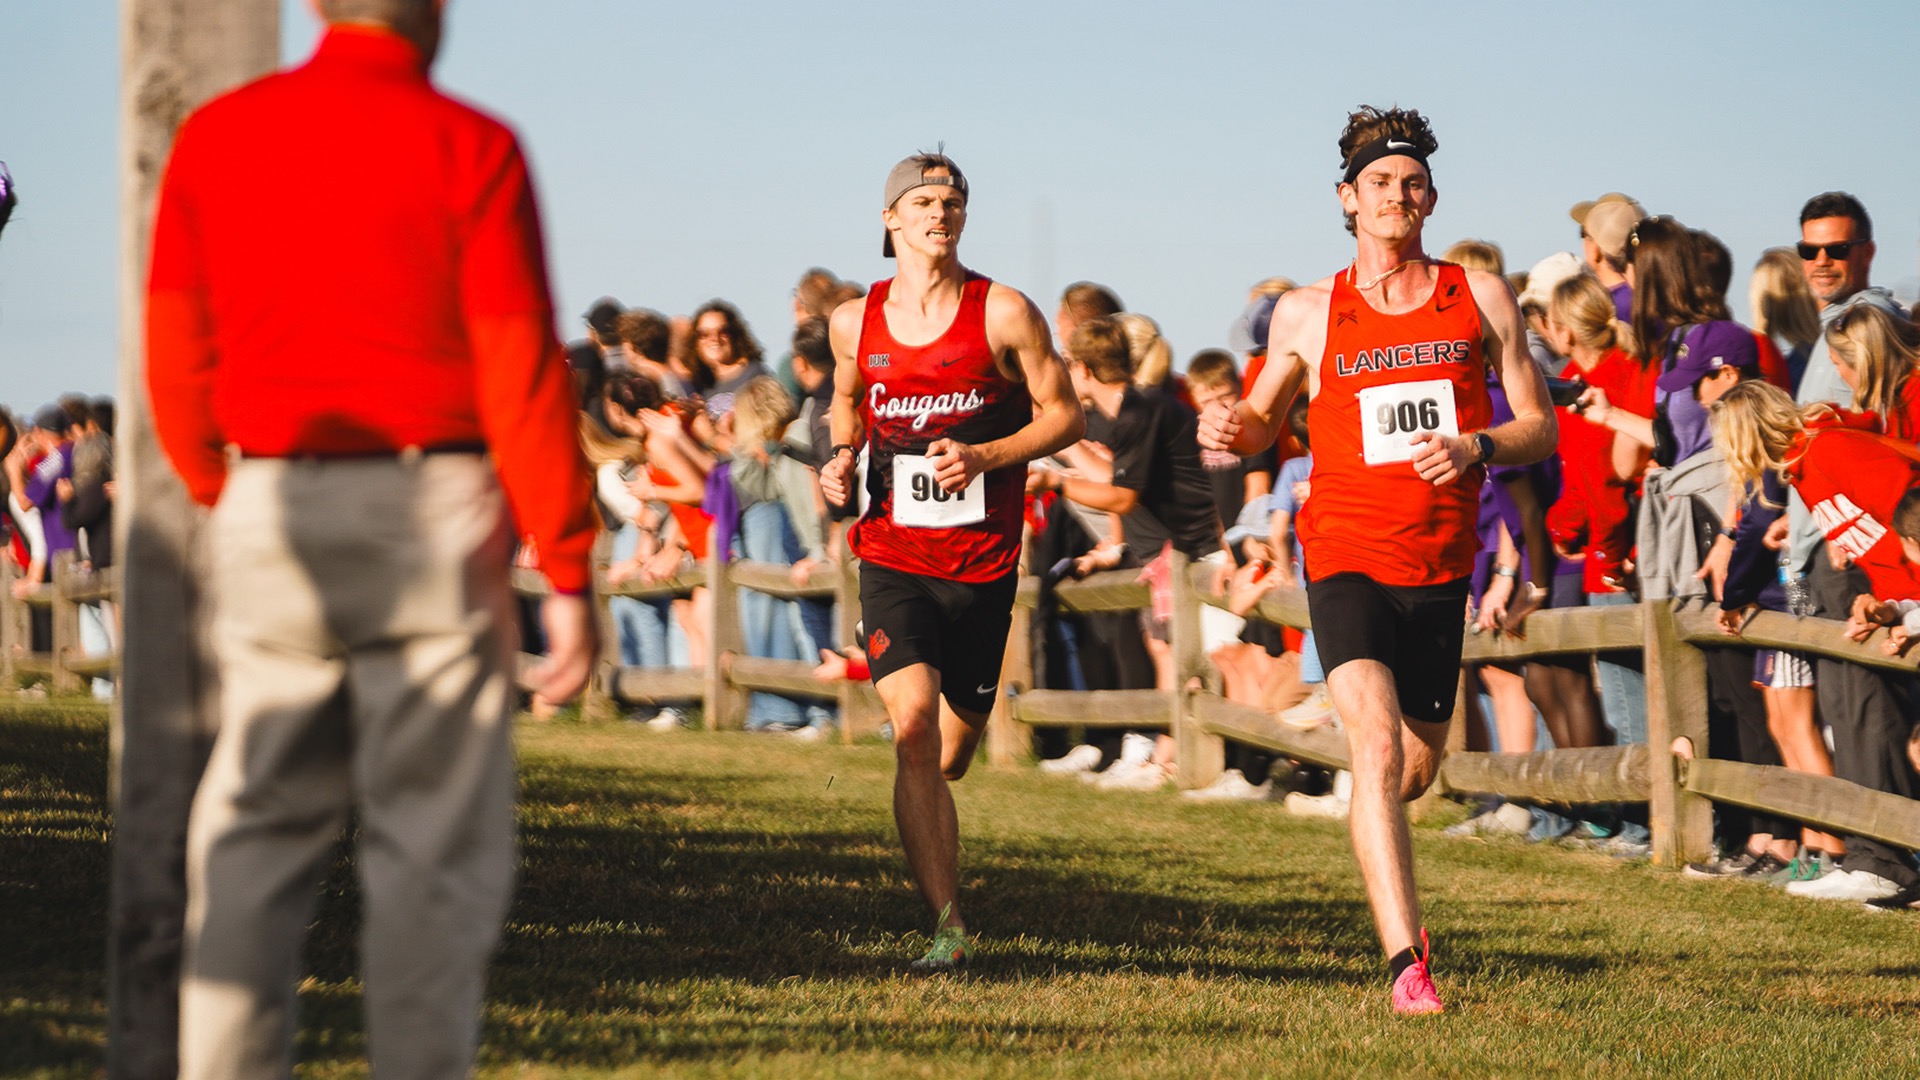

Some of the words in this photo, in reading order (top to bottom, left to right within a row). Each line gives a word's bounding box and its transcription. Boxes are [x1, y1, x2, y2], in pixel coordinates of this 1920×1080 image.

[868, 353, 890, 367] IUK
[1336, 340, 1471, 376] LANCERS
[869, 382, 984, 430] Cougars
[1376, 397, 1440, 435] 906
